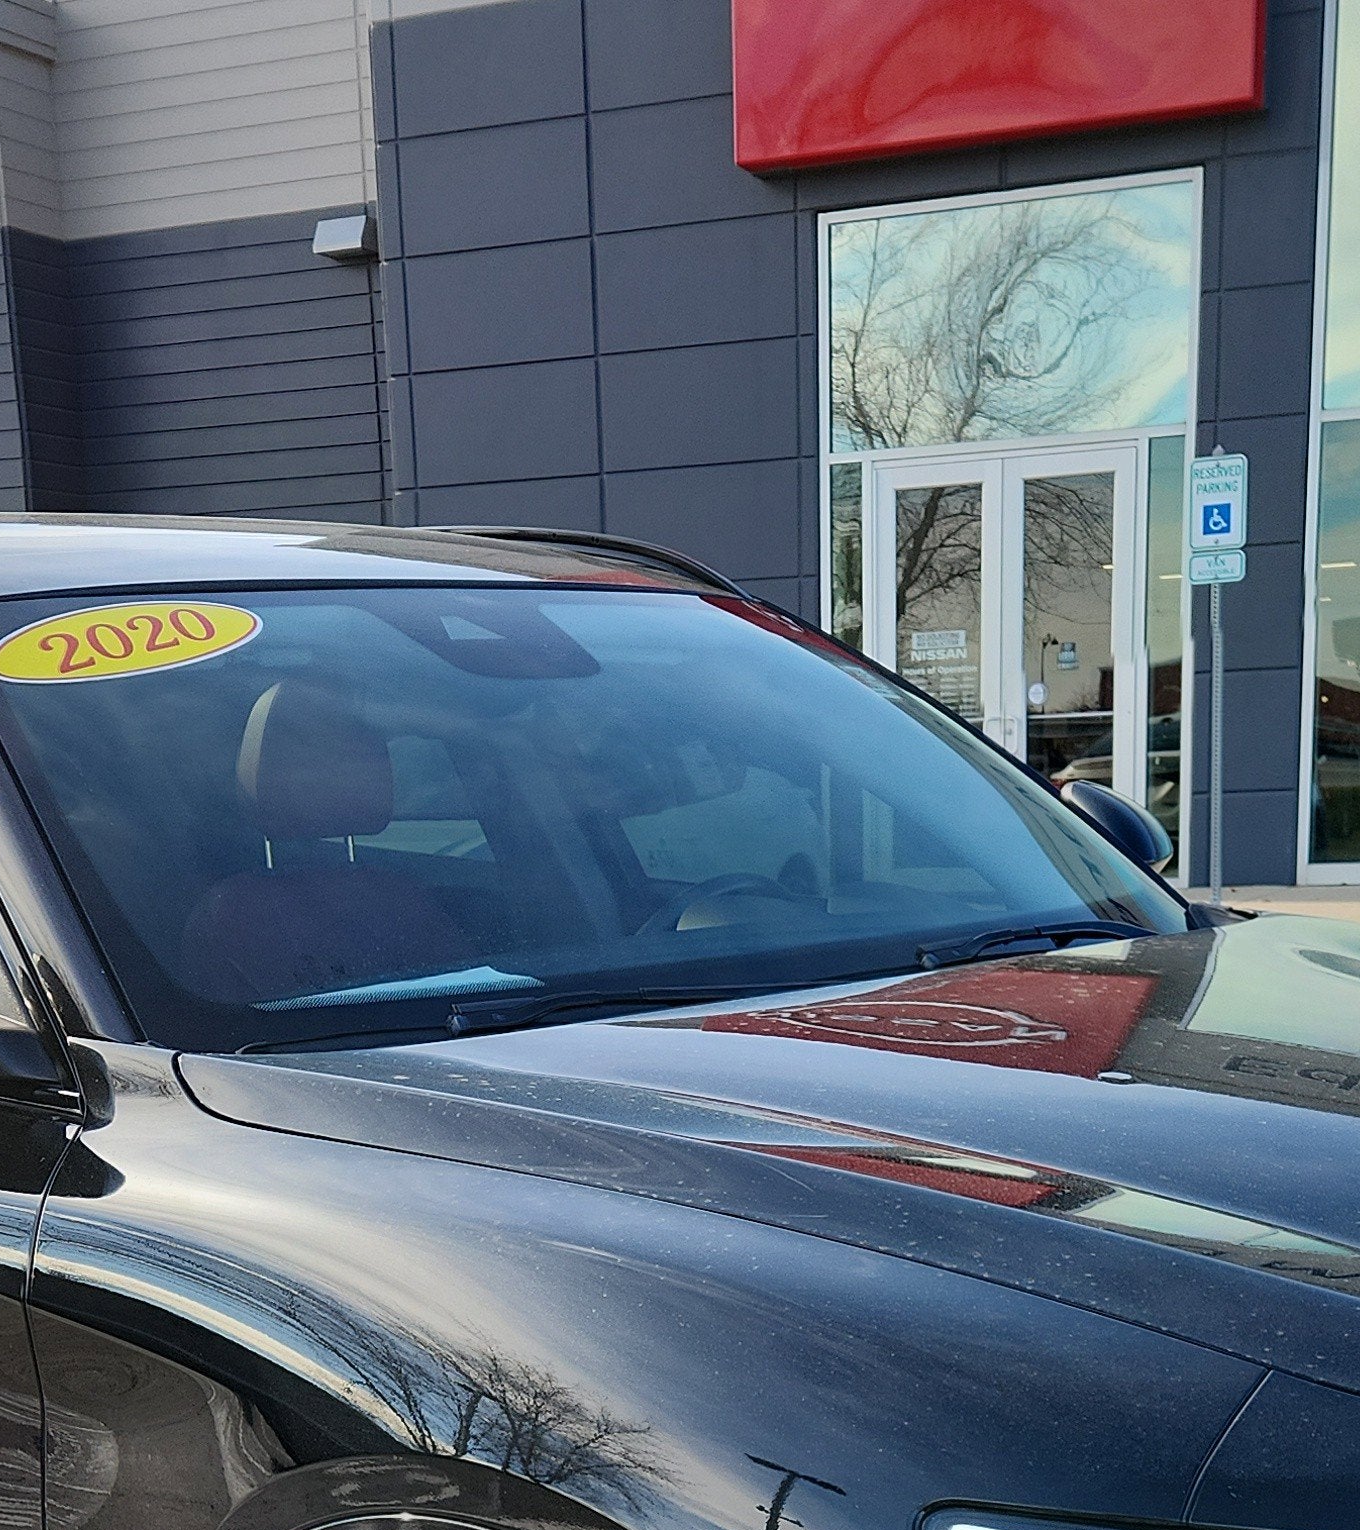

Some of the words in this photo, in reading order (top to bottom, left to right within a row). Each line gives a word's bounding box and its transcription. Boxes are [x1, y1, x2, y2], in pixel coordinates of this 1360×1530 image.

[1193, 464, 1242, 480] RESERVED
[1196, 480, 1239, 495] PARKING
[37, 607, 217, 675] 2020
[911, 647, 968, 662] NISSAN
